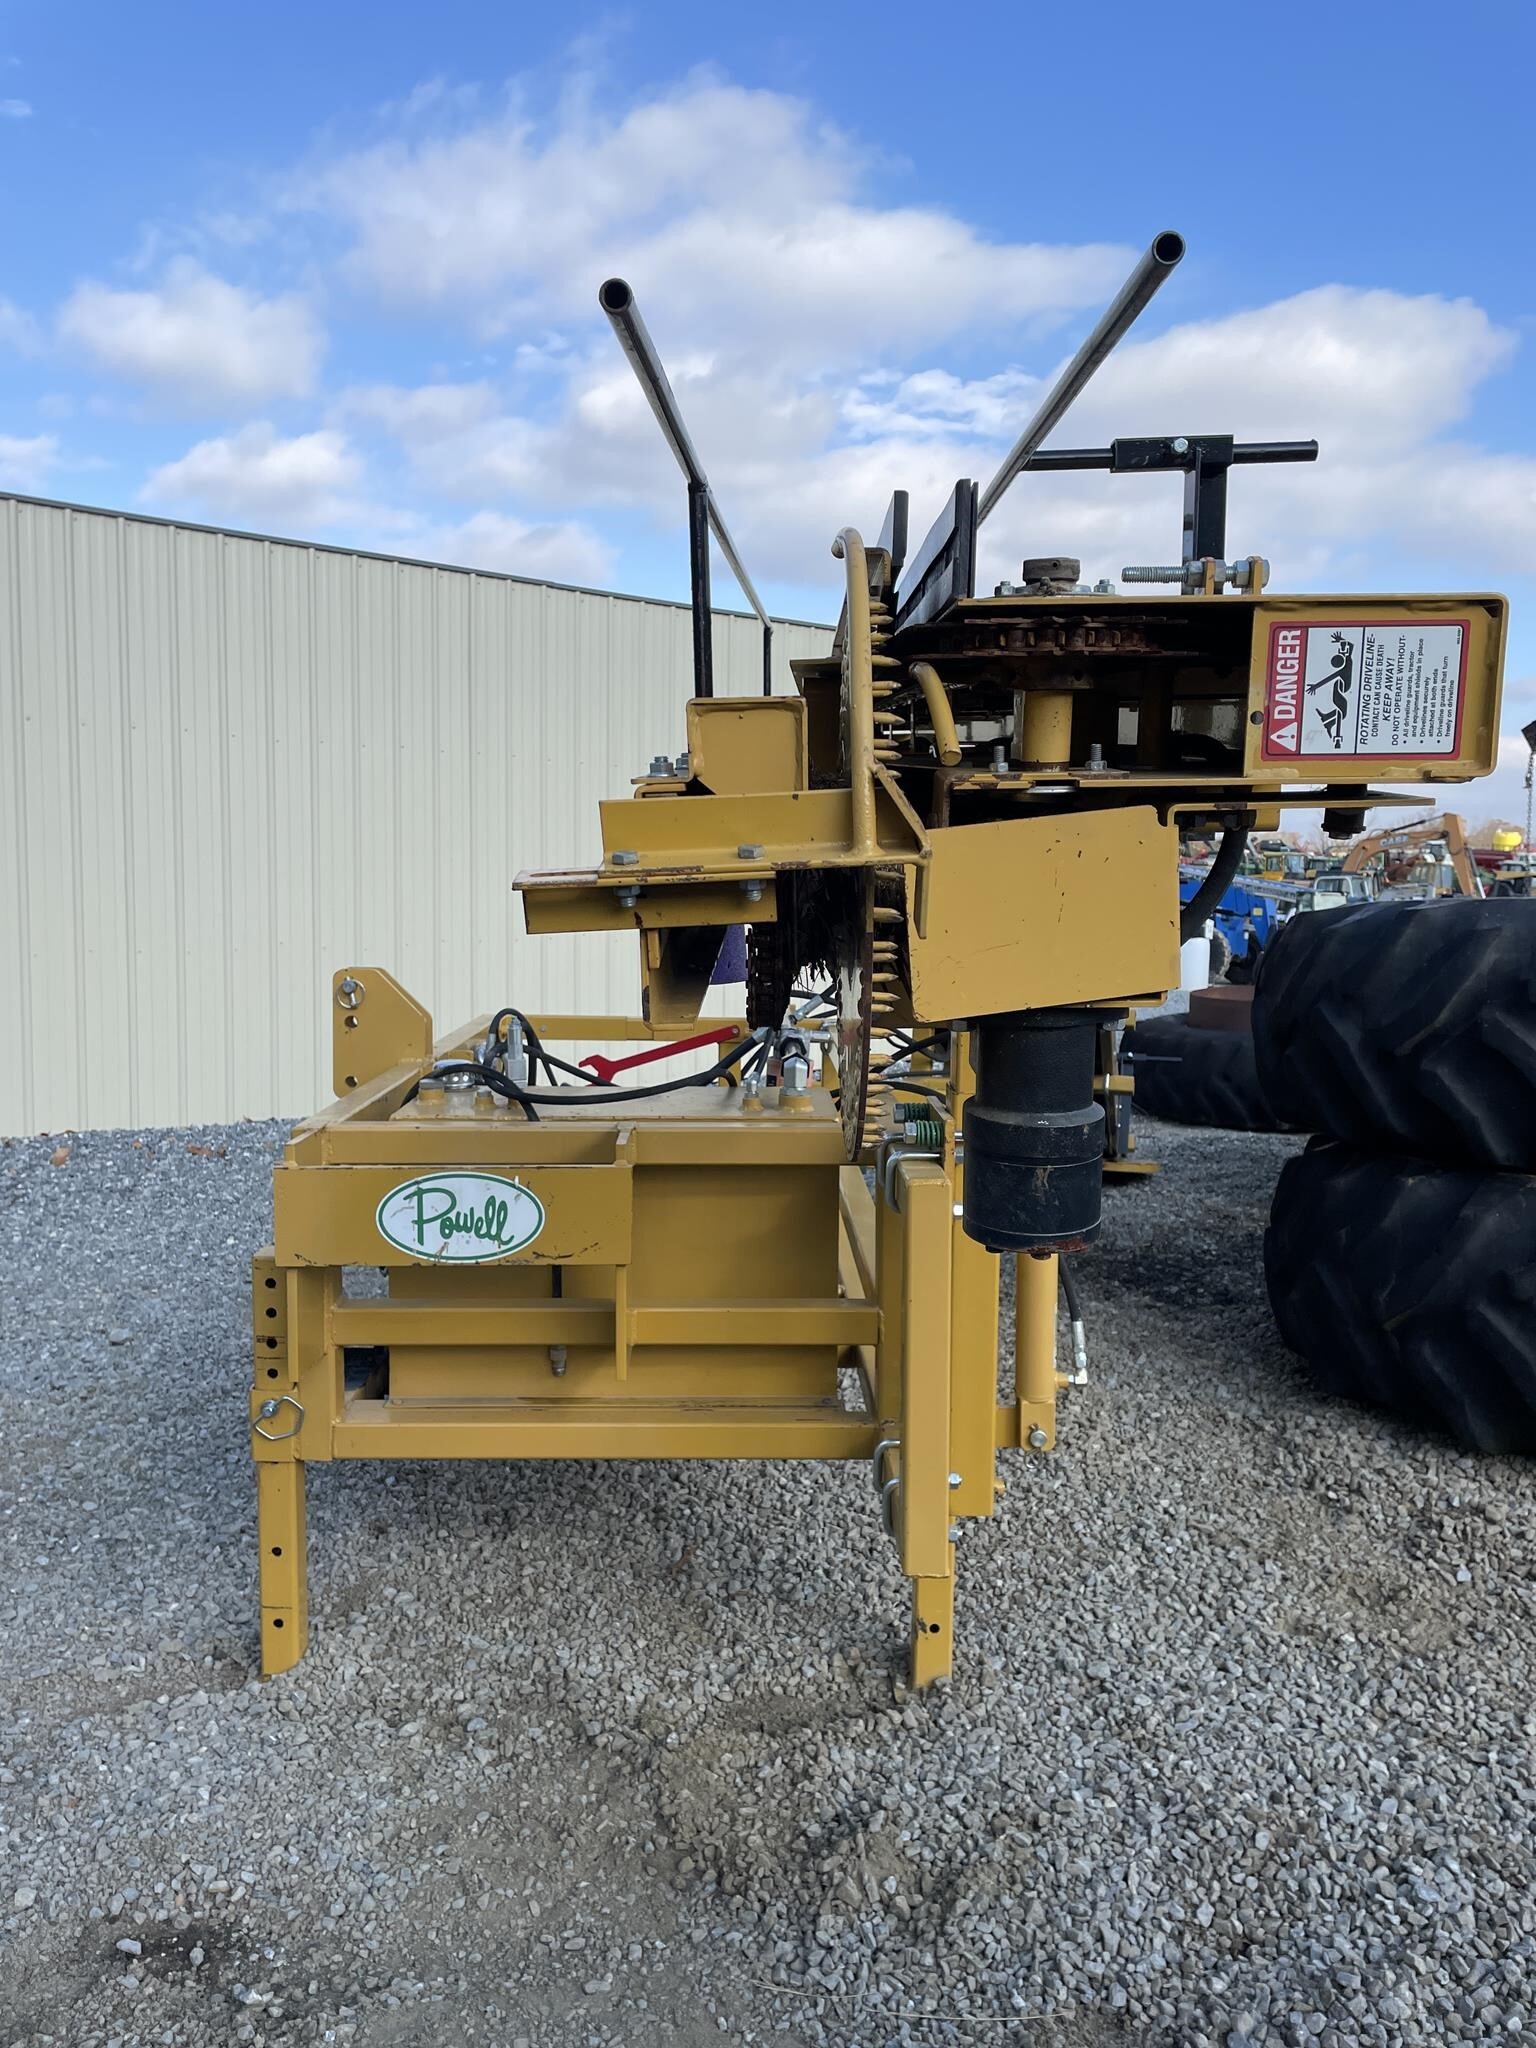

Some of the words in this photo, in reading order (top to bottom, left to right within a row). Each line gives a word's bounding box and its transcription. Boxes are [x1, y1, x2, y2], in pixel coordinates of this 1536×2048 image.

[1364, 634, 1375, 691] DRIVELINE-
[1397, 635, 1406, 674] WITHOUT-
[1274, 630, 1301, 719] DANGER
[1385, 658, 1394, 691] AWAY!
[1383, 693, 1392, 721] KEEP
[1394, 676, 1403, 713] OPERATE
[1448, 709, 1452, 717] on
[1360, 694, 1371, 745] ROTATING
[1371, 707, 1379, 737] CONTACT
[1392, 734, 1398, 745] DO
[403, 1187, 515, 1246] Powell
